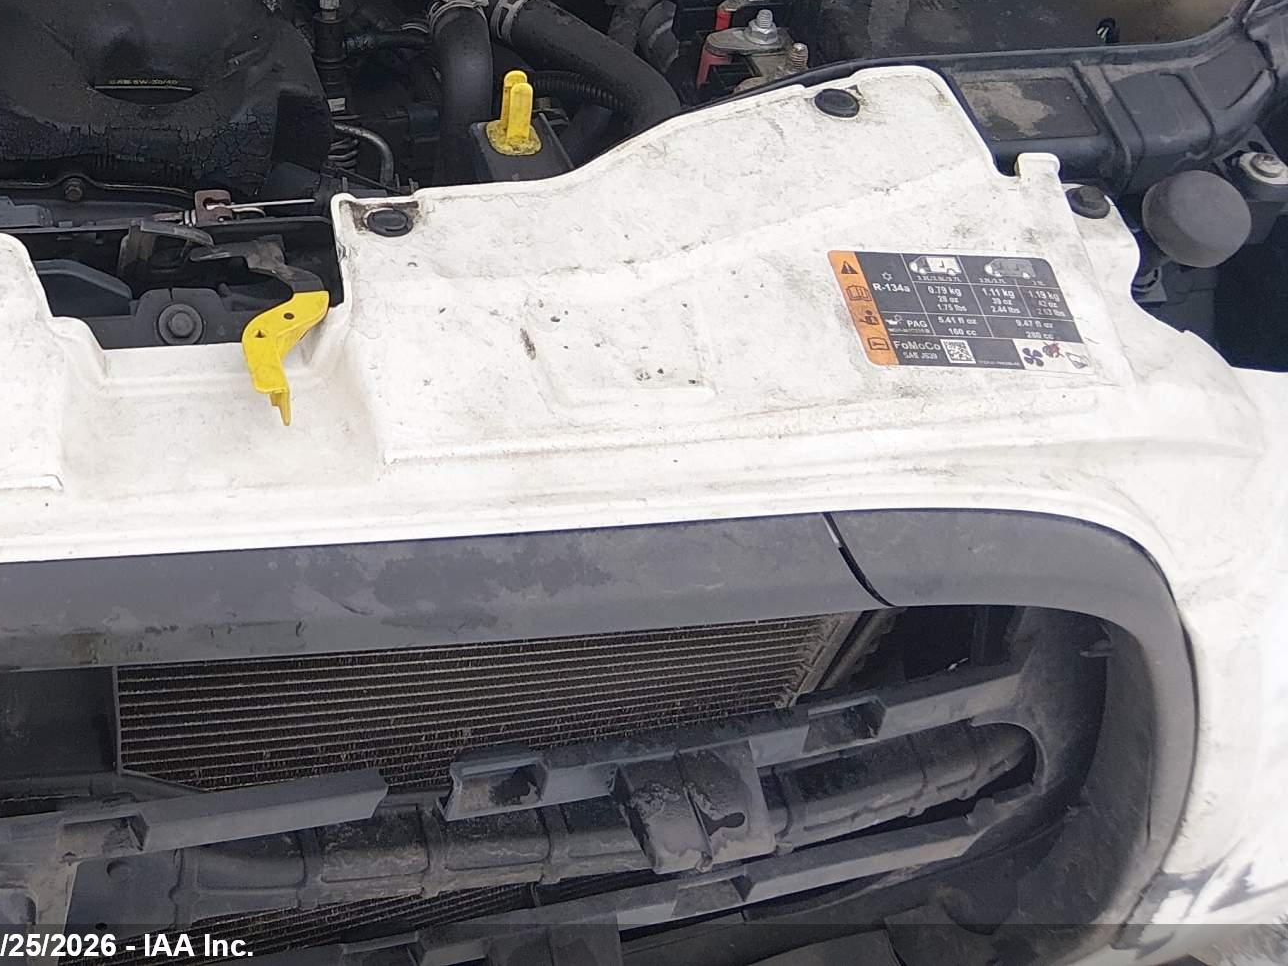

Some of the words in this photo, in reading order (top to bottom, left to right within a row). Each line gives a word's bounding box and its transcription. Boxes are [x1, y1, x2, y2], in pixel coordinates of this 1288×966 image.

[872, 283, 911, 293] R-134a
[927, 285, 947, 294] 0.79
[948, 286, 962, 297] kg
[982, 287, 1001, 296] 1.11
[1001, 288, 1015, 299] kg
[1028, 290, 1047, 299] 1.19
[1047, 291, 1060, 302] kg
[937, 295, 948, 303] 28
[992, 297, 1002, 305] 39
[937, 303, 953, 311] 1.75
[954, 304, 967, 312] lbs
[990, 305, 1007, 313] 2.44
[1007, 306, 1021, 314] lbs
[906, 319, 928, 328] PAG
[937, 316, 956, 324] 5.41
[948, 327, 964, 336] 160
[893, 340, 941, 351] FoMoCo
